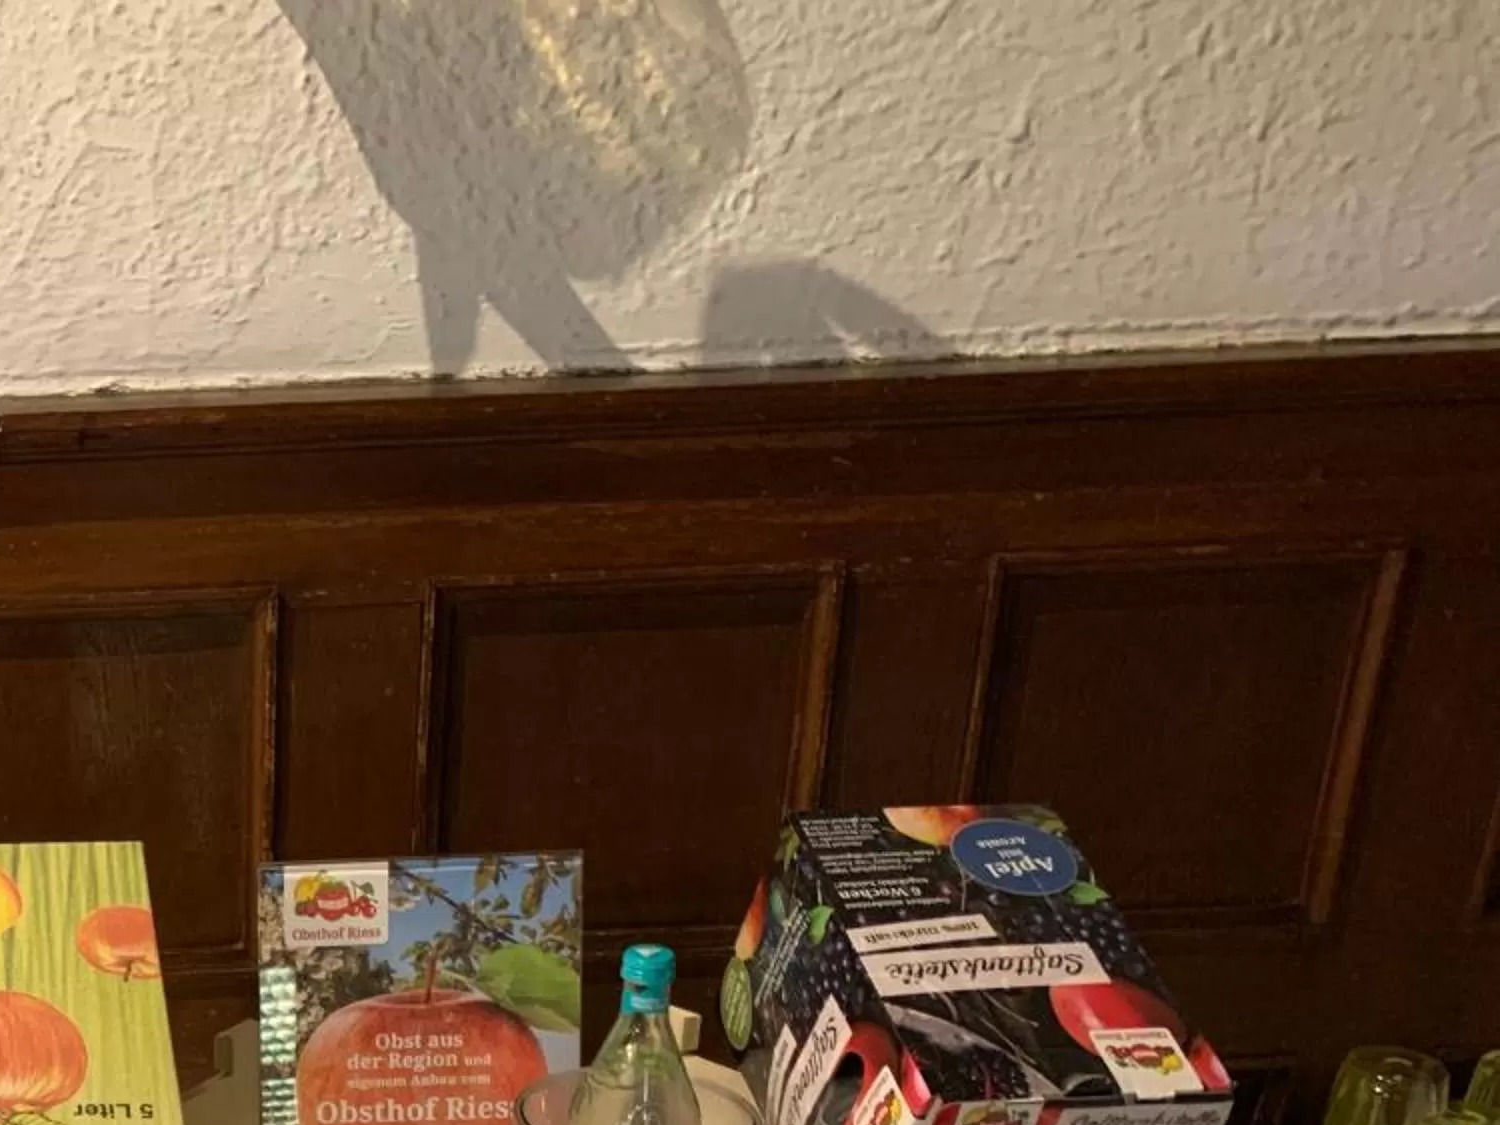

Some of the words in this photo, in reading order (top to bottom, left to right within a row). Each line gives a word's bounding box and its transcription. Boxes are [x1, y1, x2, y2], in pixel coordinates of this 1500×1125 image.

[984, 854, 1054, 879] Apfel
[838, 886, 909, 900] Wochen
[910, 886, 922, 897] 6
[375, 1032, 423, 1050] Obst
[428, 1034, 465, 1048] aus
[347, 1054, 383, 1070] der
[387, 1052, 459, 1073] Region
[464, 1053, 492, 1066] und
[73, 1103, 132, 1119] Liter
[140, 1104, 153, 1119] 5
[316, 1096, 441, 1125] Obsthof
